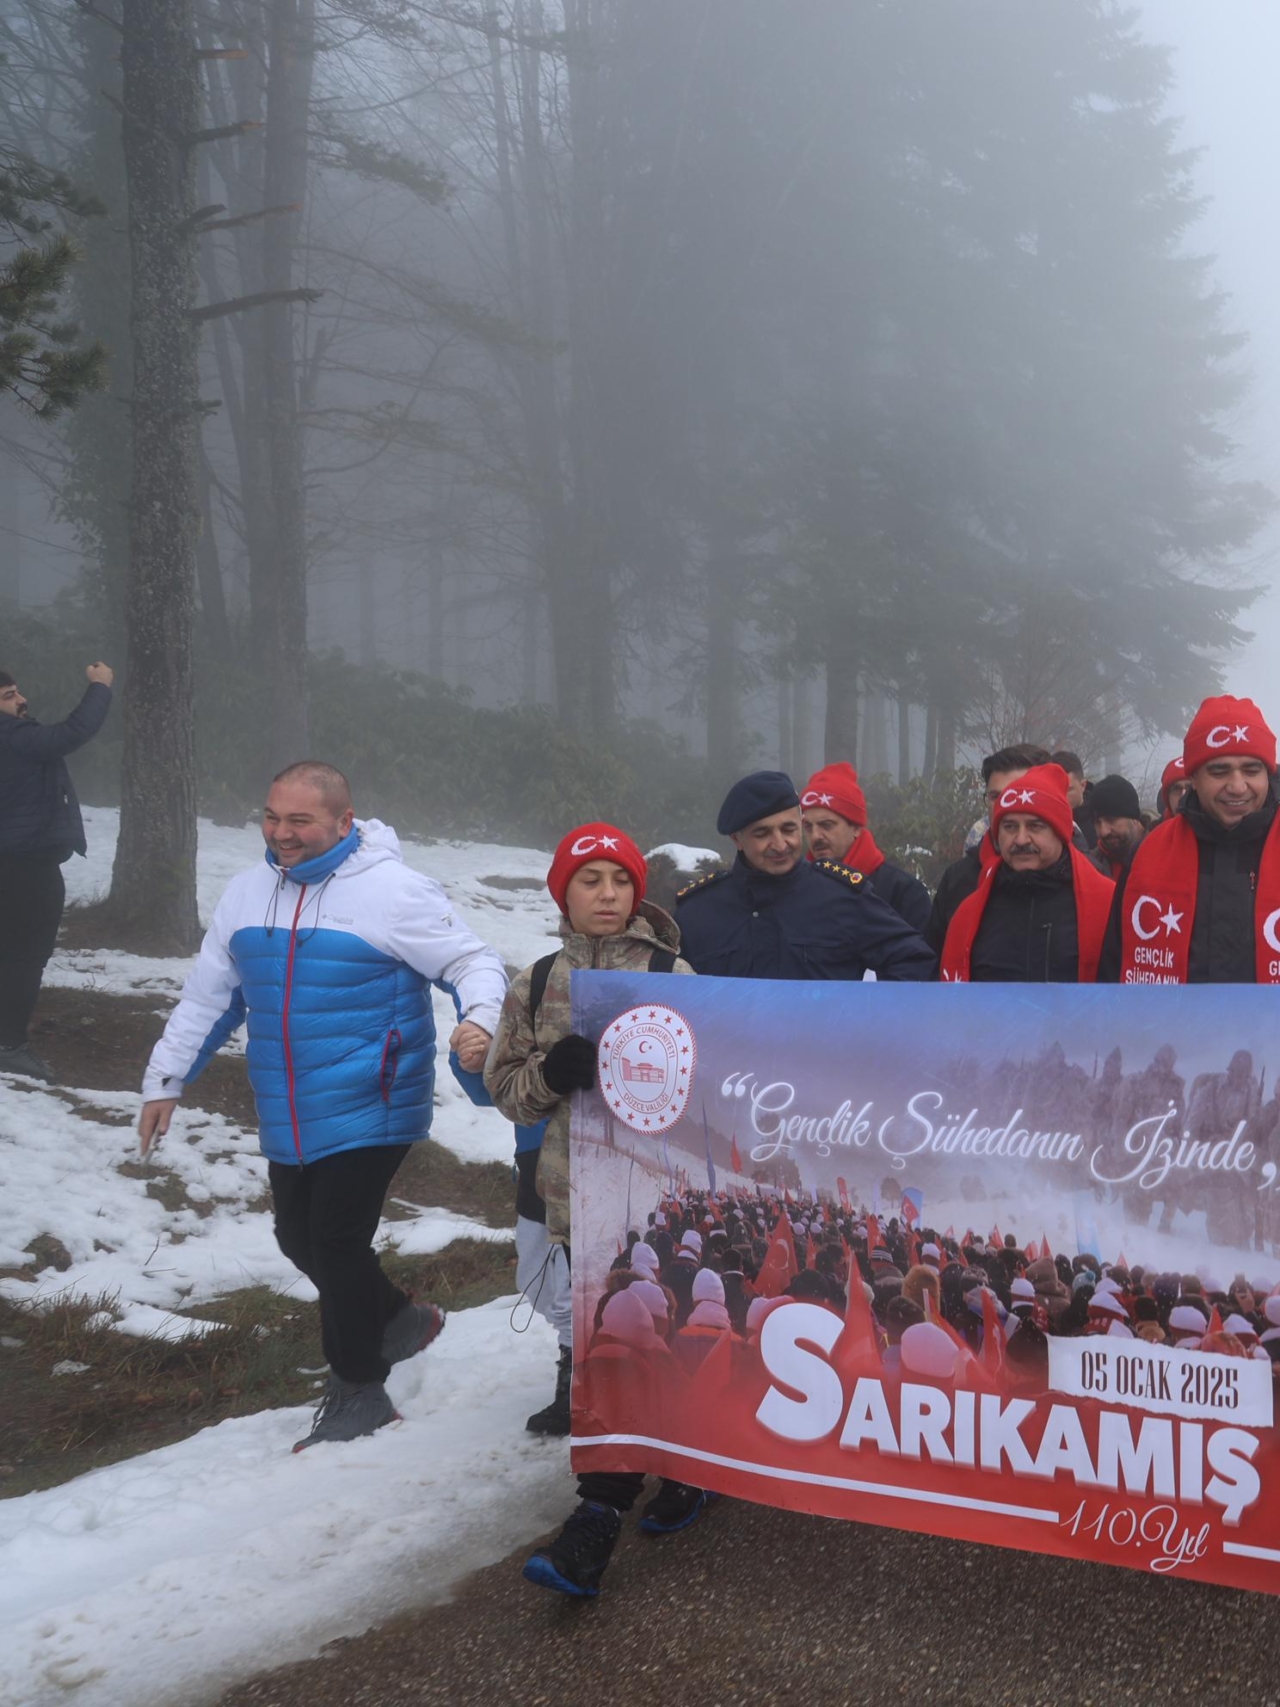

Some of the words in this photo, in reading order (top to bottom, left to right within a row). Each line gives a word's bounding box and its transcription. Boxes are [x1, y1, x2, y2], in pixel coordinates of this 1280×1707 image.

[1134, 947, 1174, 969] GENÇLİK
[1081, 1351, 1108, 1392] 05
[1116, 1355, 1173, 1401] OCAK
[1181, 1363, 1239, 1409] 2025
[756, 1302, 1261, 1527] SARIKAMIŞ
